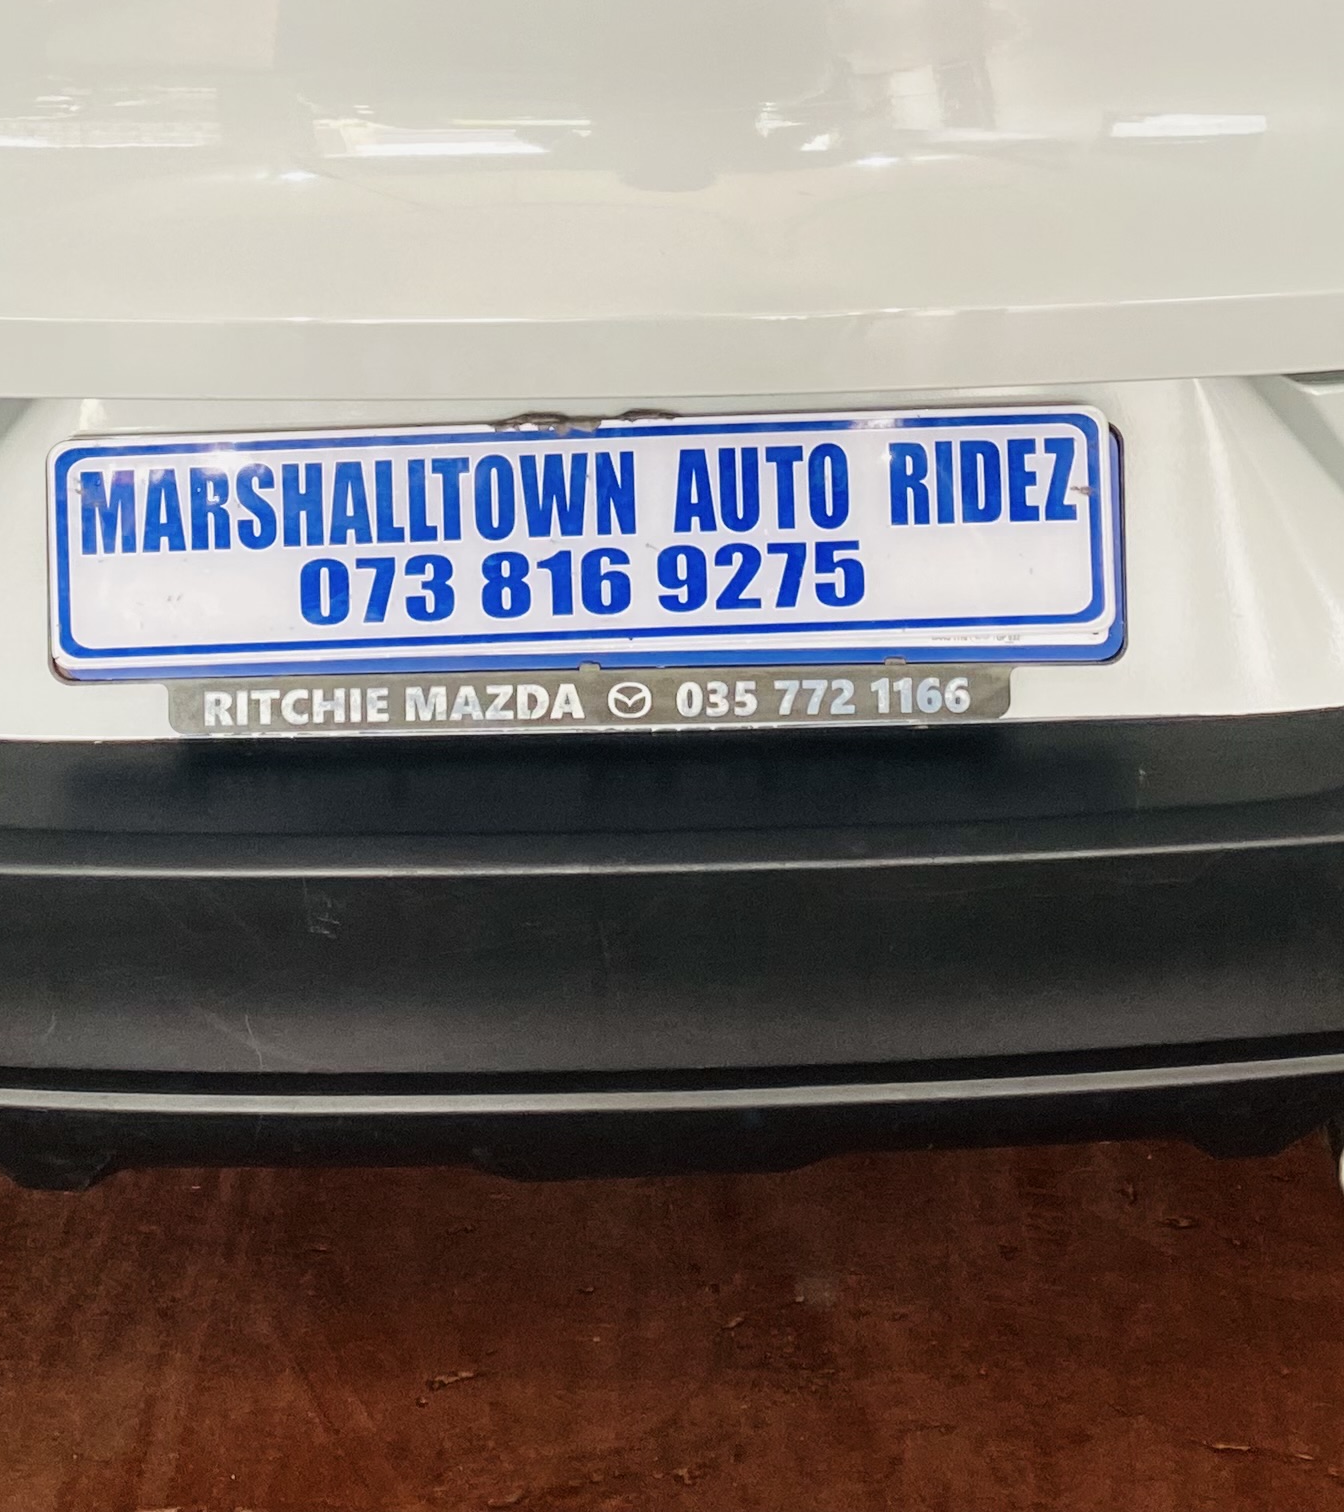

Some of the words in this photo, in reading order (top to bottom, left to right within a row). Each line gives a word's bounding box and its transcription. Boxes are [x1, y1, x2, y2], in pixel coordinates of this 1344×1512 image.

[80, 451, 637, 556] MARSHALLTOWN
[674, 443, 849, 533] AUTO
[889, 437, 1077, 526] RIDEZ
[300, 554, 455, 626] 073
[481, 547, 632, 620] 816
[657, 540, 866, 613] 9275
[203, 688, 390, 727] RITCHIE
[404, 683, 586, 722] MAZDA
[676, 681, 757, 718] 035
[774, 680, 856, 716] 772
[871, 677, 971, 714] 1166
